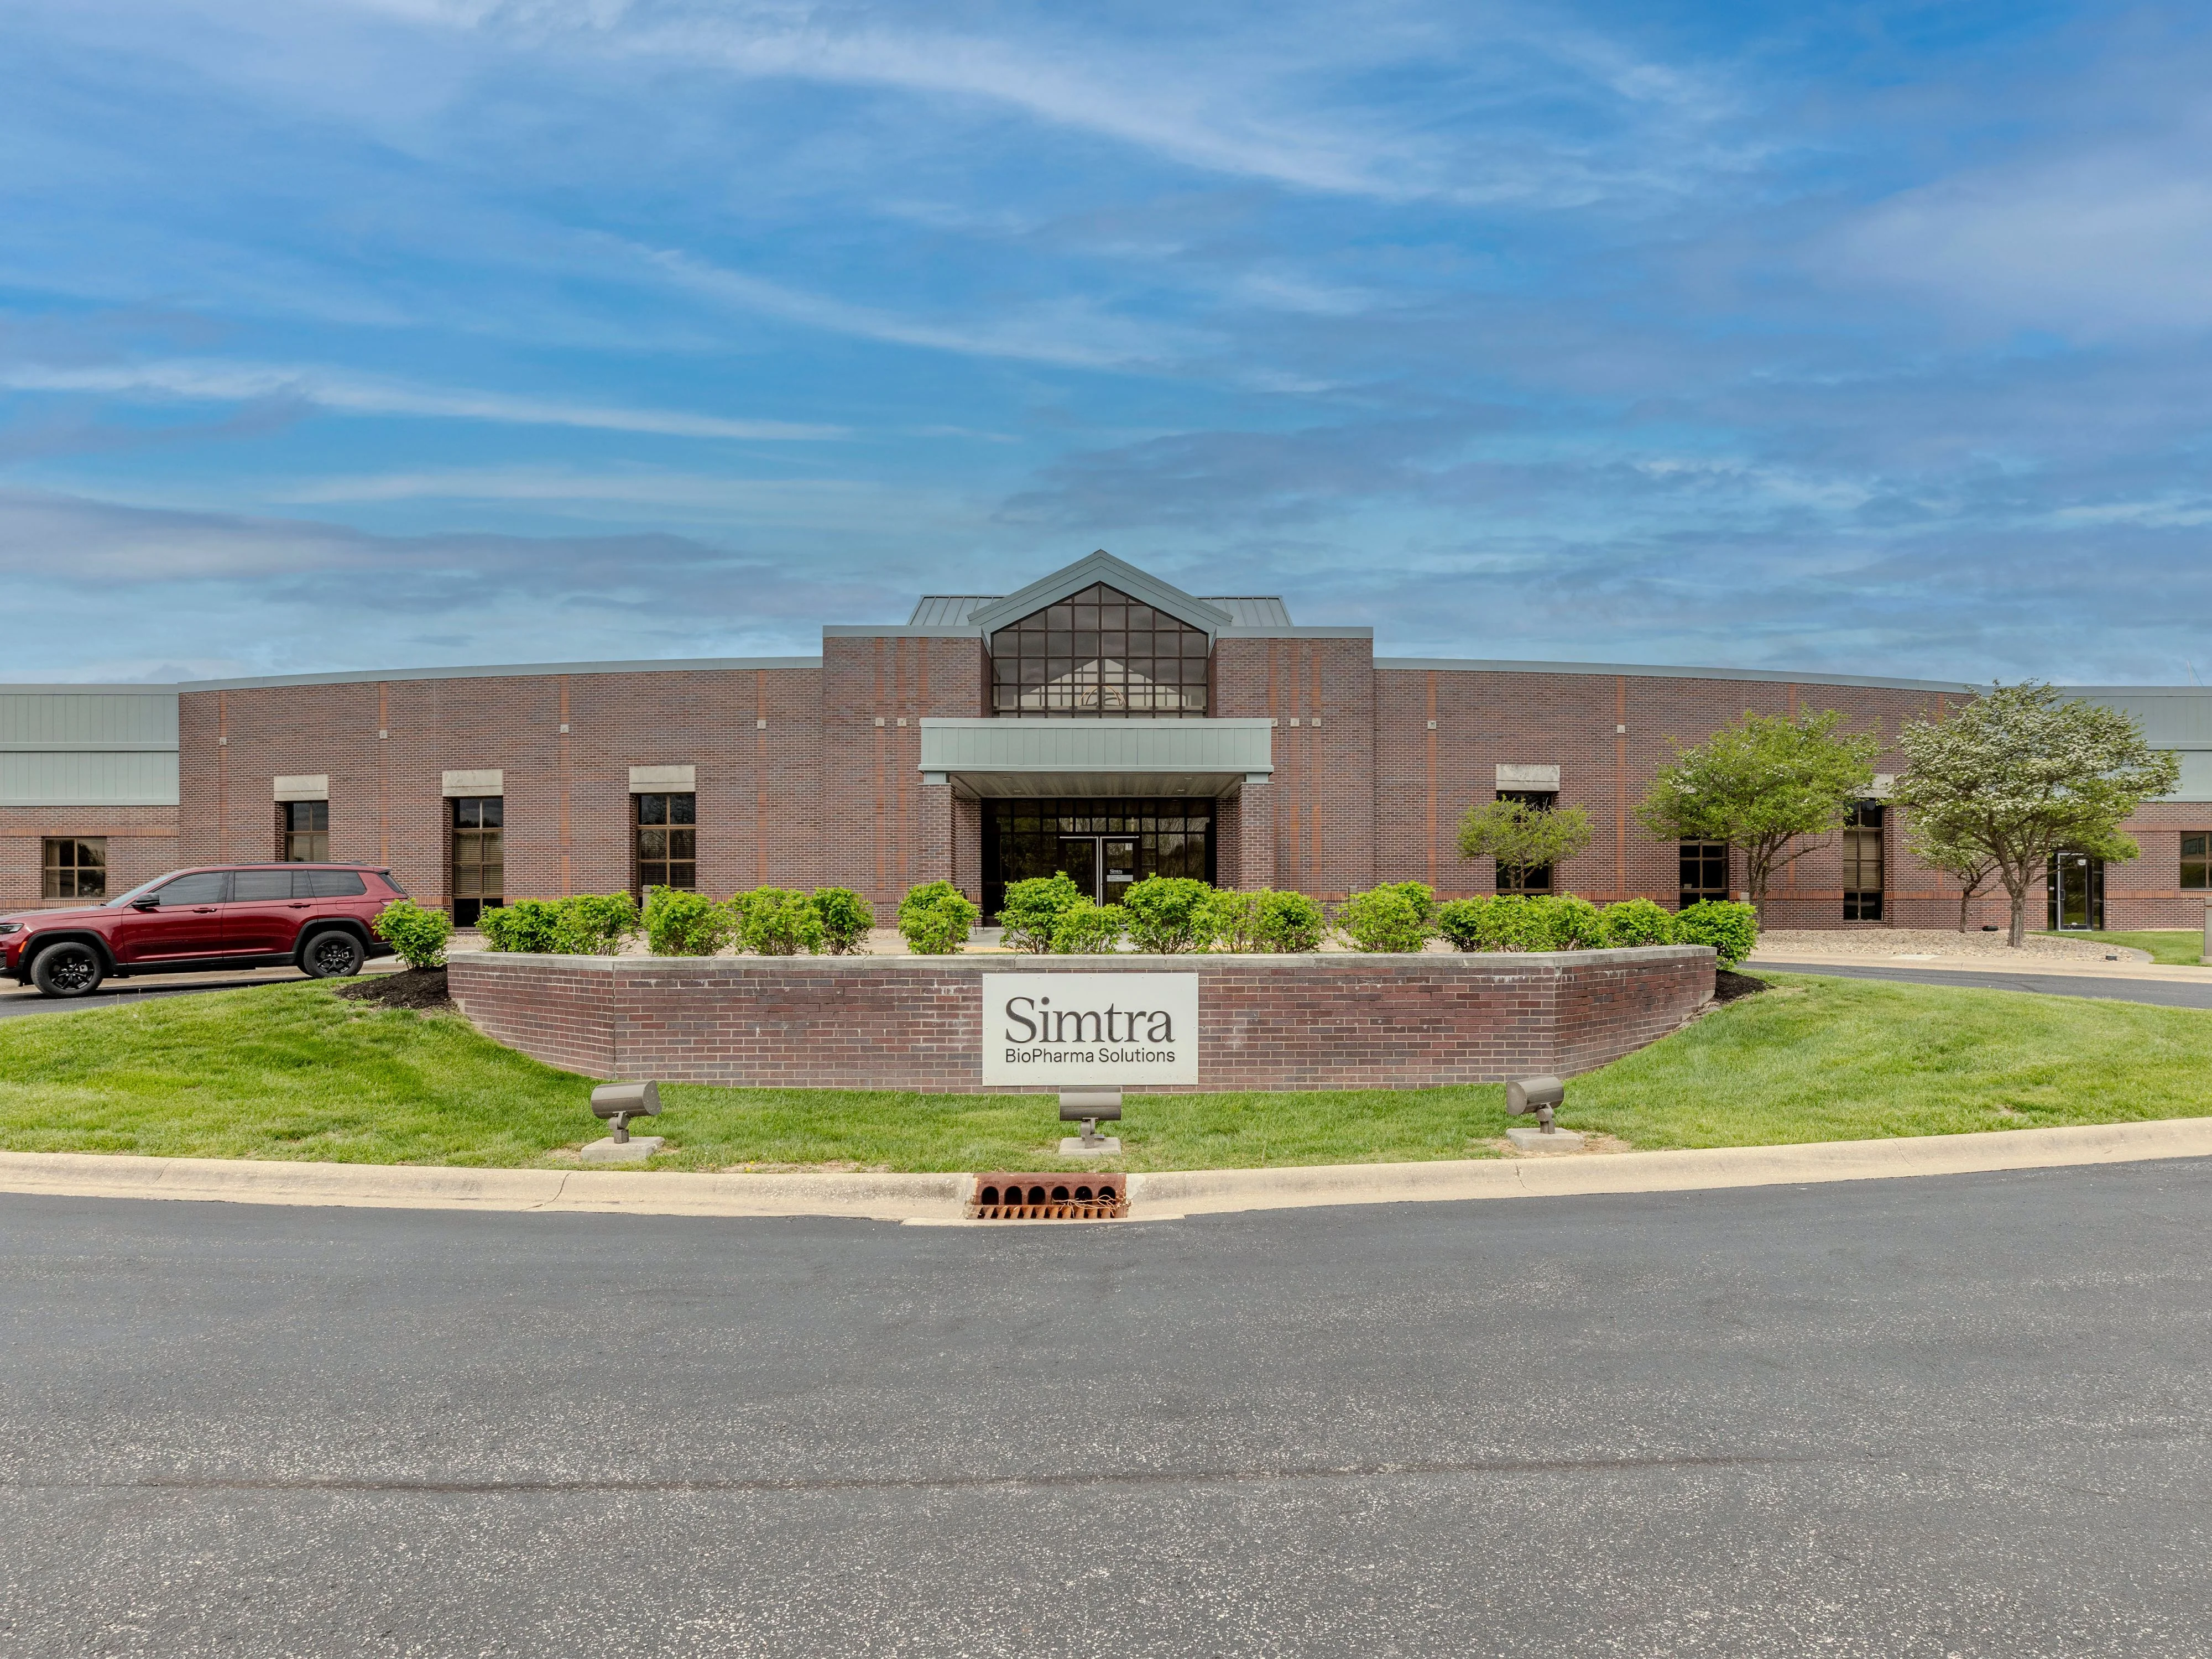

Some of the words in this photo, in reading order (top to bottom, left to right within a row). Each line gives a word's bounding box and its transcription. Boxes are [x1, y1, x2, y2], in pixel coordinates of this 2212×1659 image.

[1005, 997, 1176, 1044] Simtra
[1006, 1048, 1094, 1063] BioPharma
[1099, 1047, 1175, 1063] Solutions
